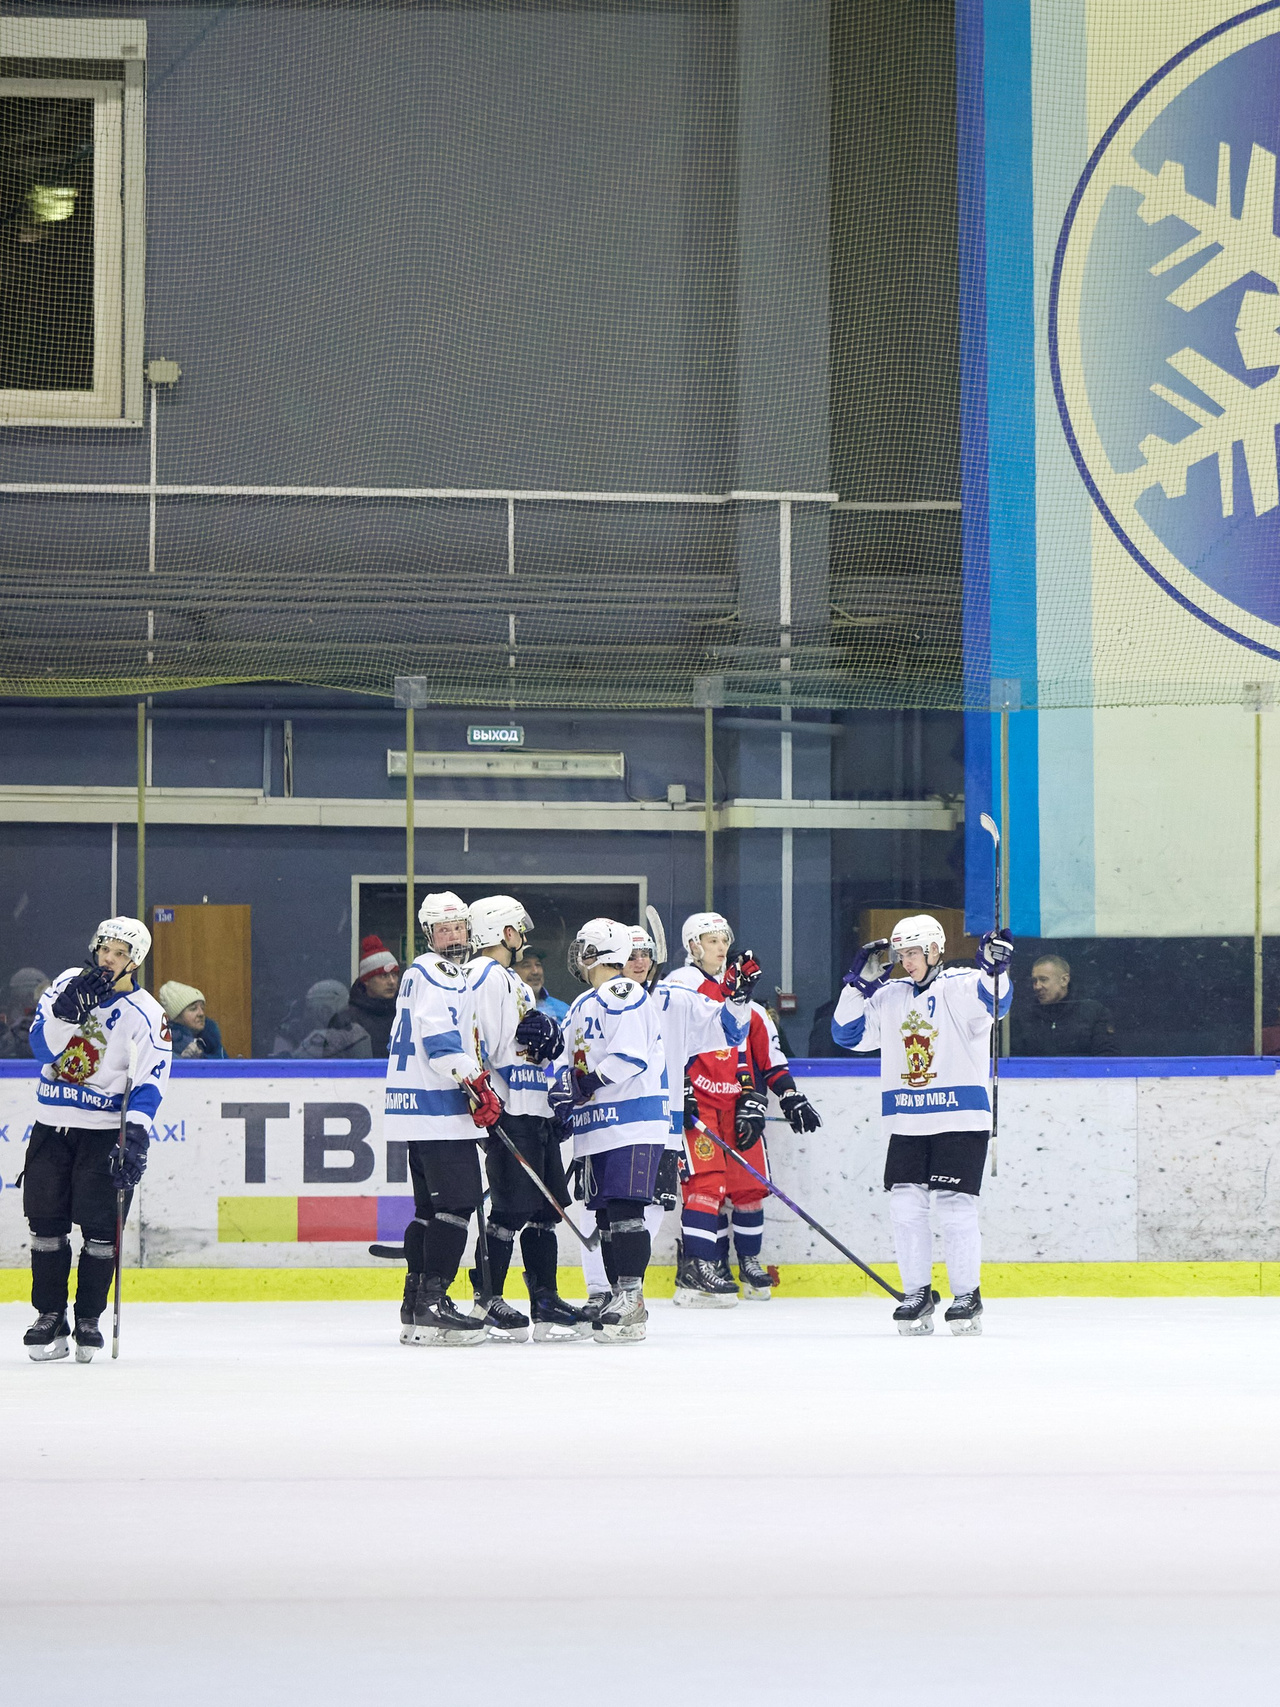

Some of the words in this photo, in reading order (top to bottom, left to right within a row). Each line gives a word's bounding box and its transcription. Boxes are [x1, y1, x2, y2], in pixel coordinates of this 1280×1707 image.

[473, 729, 519, 742] ВЫХОД
[660, 990, 670, 1011] 7
[106, 1008, 121, 1031] 8
[385, 1092, 419, 1110] ИБИРСК
[926, 1091, 959, 1108] МВД
[930, 1175, 961, 1185] CCM
